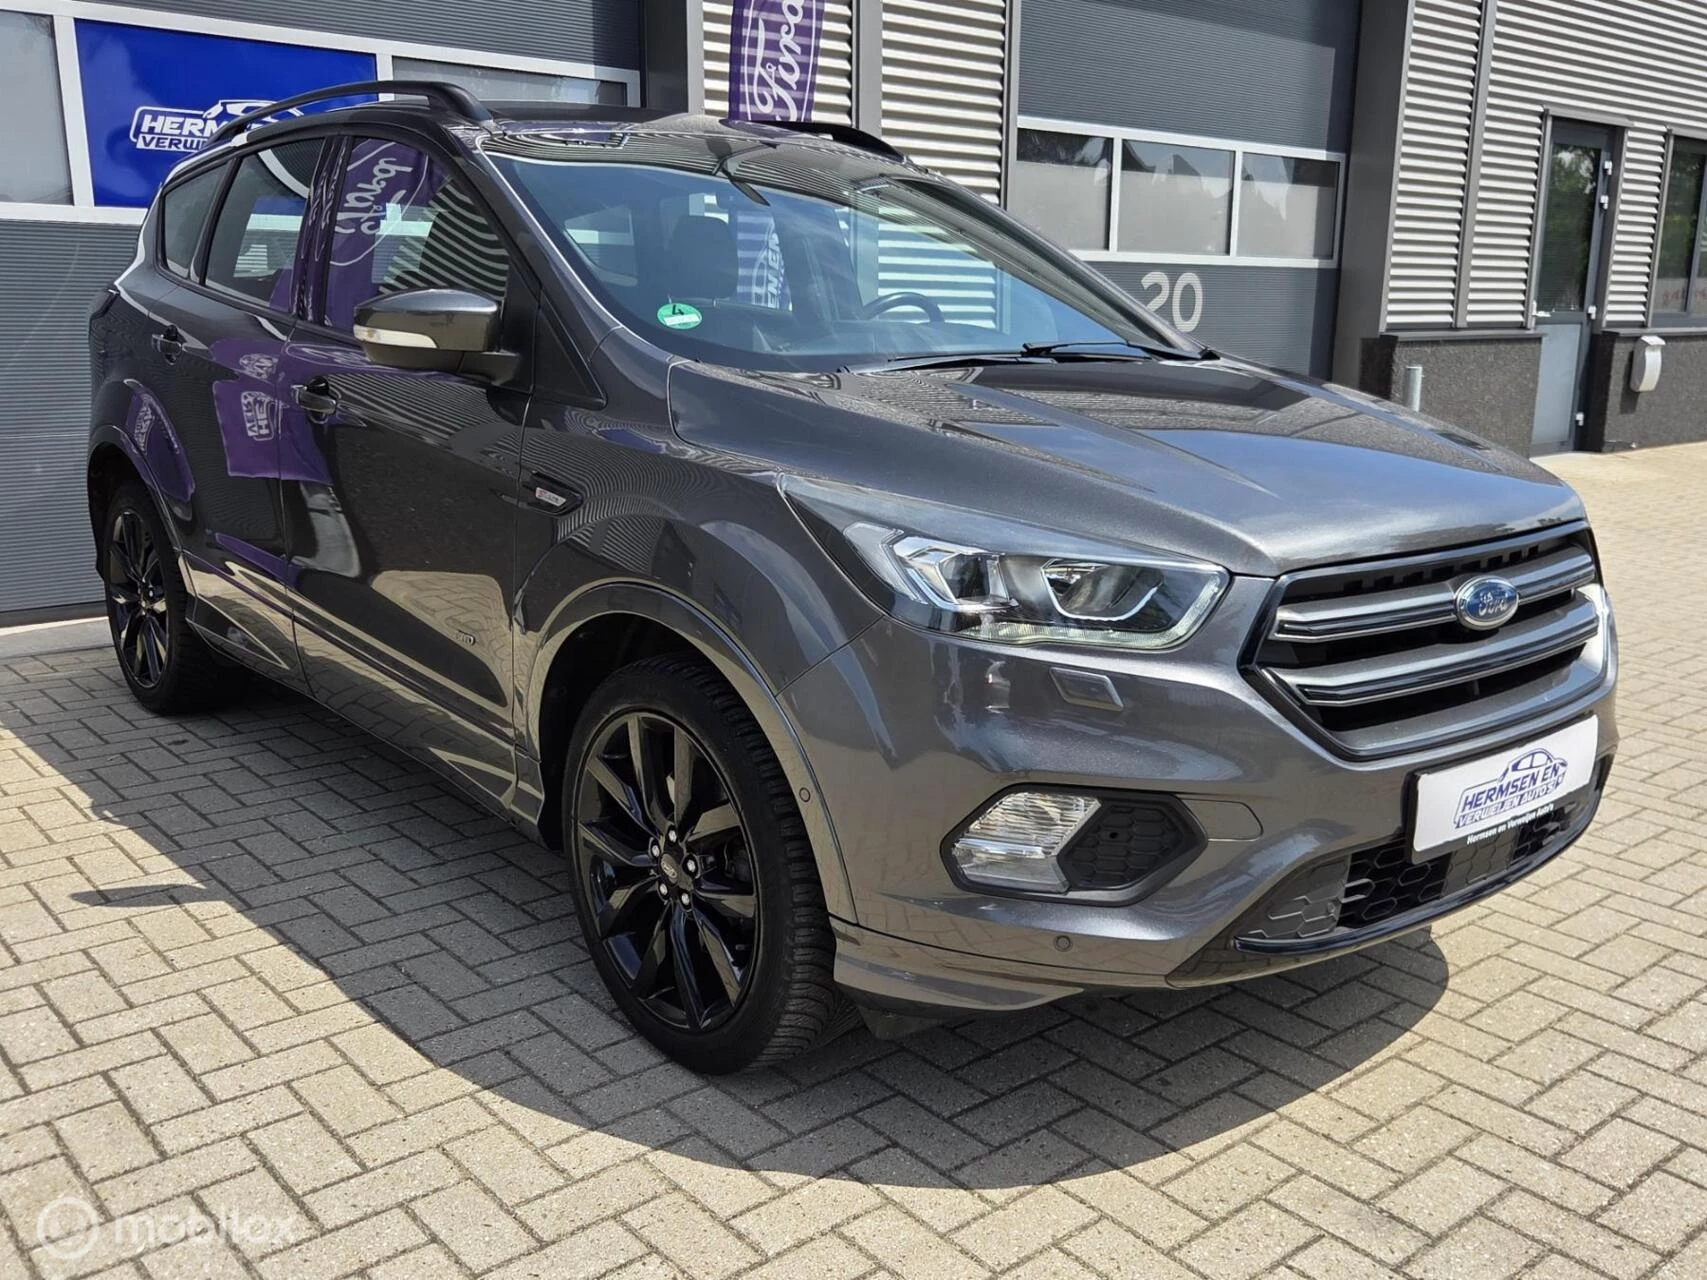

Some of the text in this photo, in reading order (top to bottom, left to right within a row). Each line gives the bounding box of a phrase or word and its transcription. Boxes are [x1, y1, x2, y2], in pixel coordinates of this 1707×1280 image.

[141, 114, 228, 137] HERM
[141, 135, 207, 151] VERW
[1141, 271, 1203, 332] 20
[1461, 762, 1560, 813] HERMSEN EN
